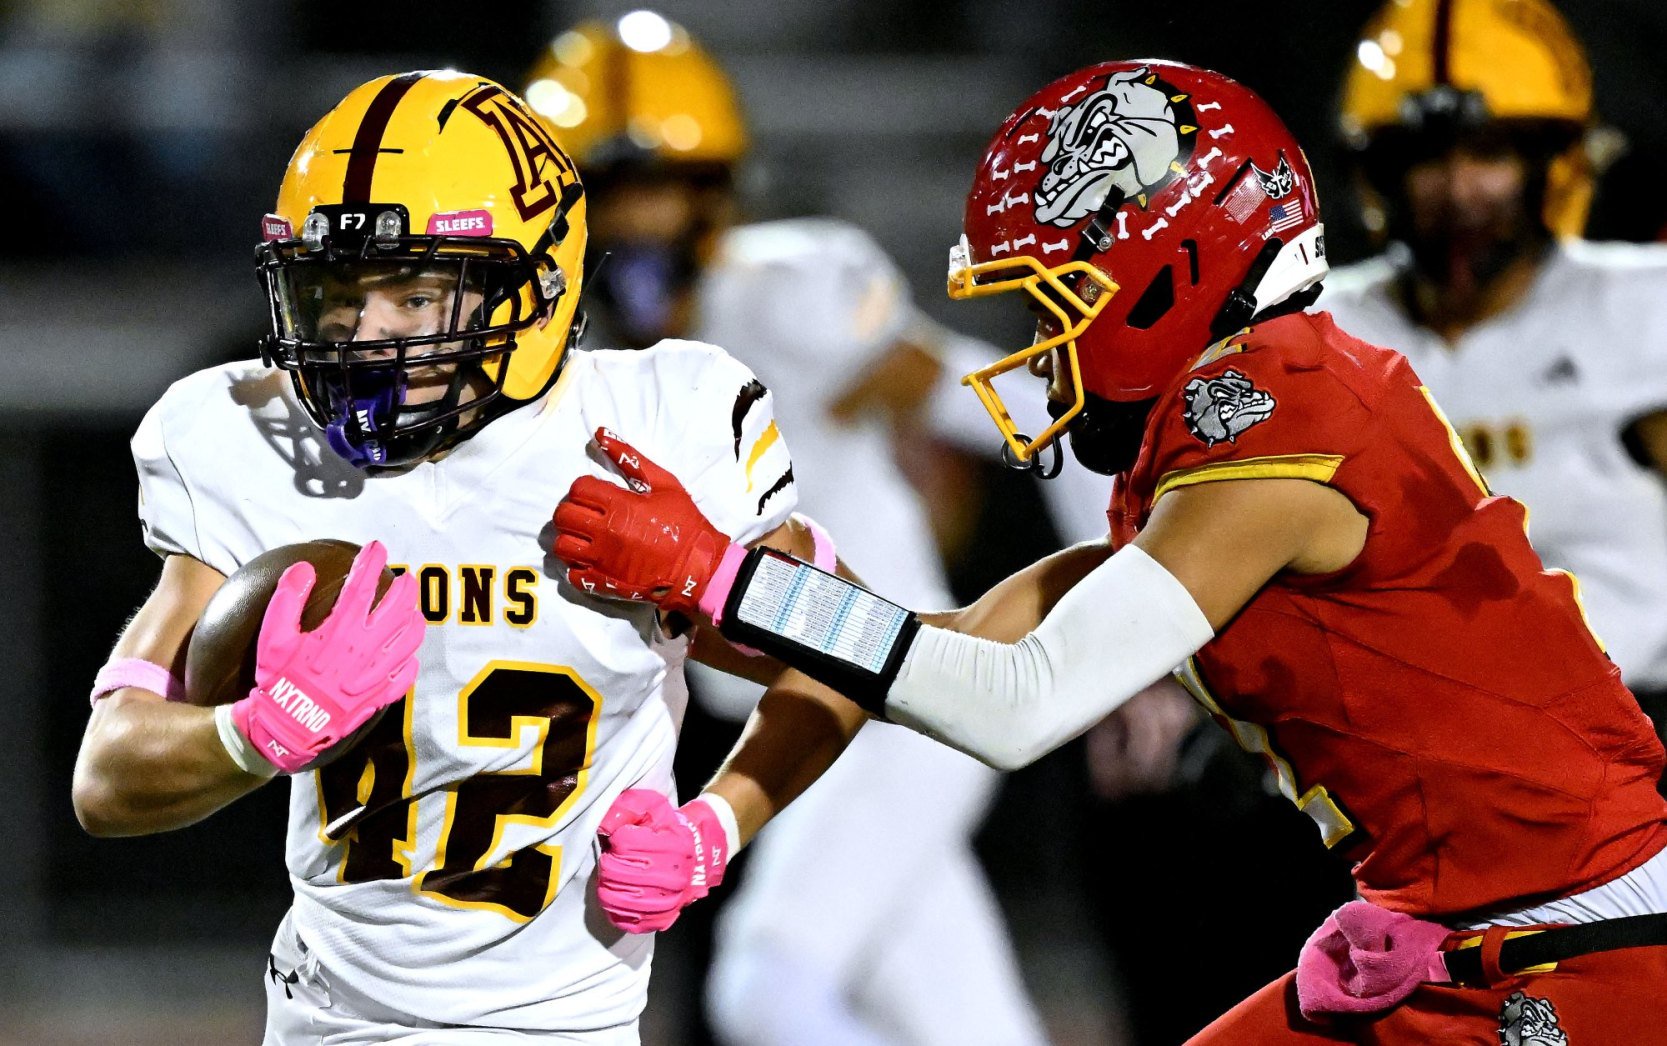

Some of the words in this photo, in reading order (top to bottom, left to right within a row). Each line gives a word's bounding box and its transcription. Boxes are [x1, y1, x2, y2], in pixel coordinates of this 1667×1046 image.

[340, 213, 366, 230] F7
[435, 217, 485, 233] SLEEFS
[268, 677, 331, 733] NXTRND
[314, 659, 603, 924] 42
